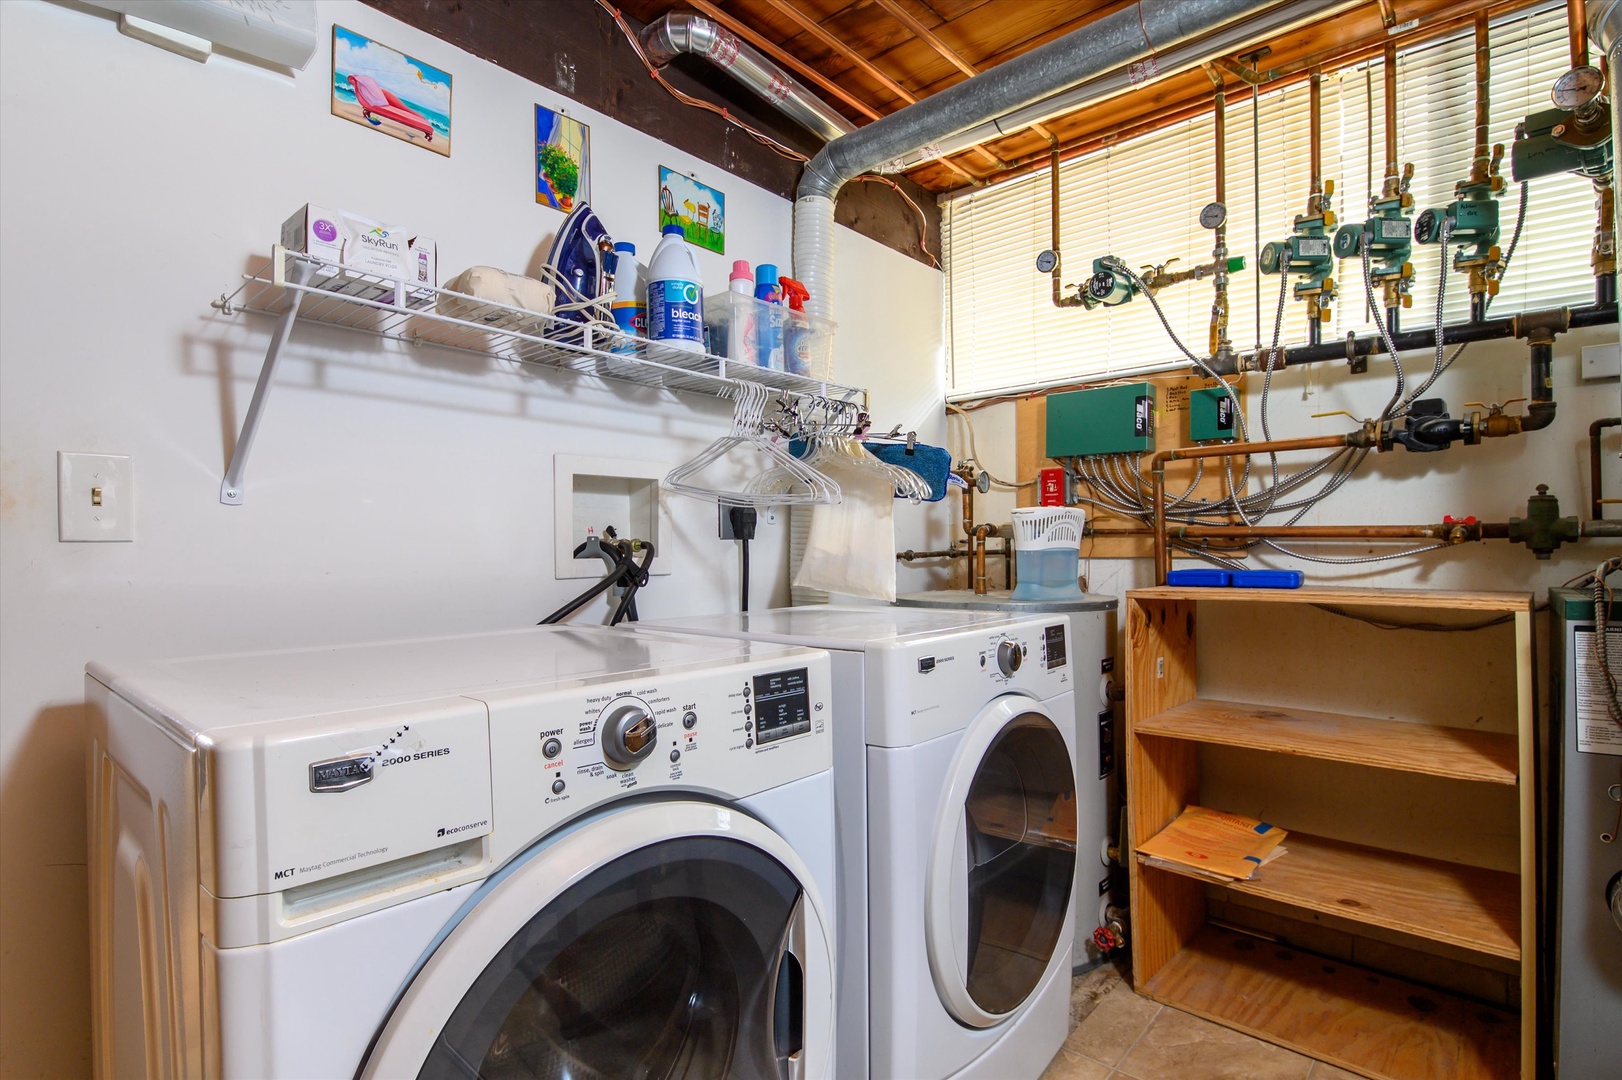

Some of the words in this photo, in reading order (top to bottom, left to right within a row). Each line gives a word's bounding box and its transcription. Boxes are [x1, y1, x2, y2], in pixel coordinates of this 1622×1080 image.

[361, 234, 399, 251] SkyRun
[671, 308, 702, 324] bleach
[770, 314, 784, 328] Siz
[648, 697, 670, 705] comforters
[682, 703, 697, 712] start
[540, 727, 564, 740] power
[684, 731, 698, 740] pause
[573, 737, 593, 746] allergen
[382, 755, 411, 767] 2000
[413, 747, 450, 761] SERIES
[544, 760, 564, 770] cancel
[446, 819, 488, 836] ecoconserve
[274, 868, 296, 880] MCT
[299, 864, 322, 874] Maytag
[322, 854, 357, 868] Commercial
[358, 846, 389, 858] Technology
